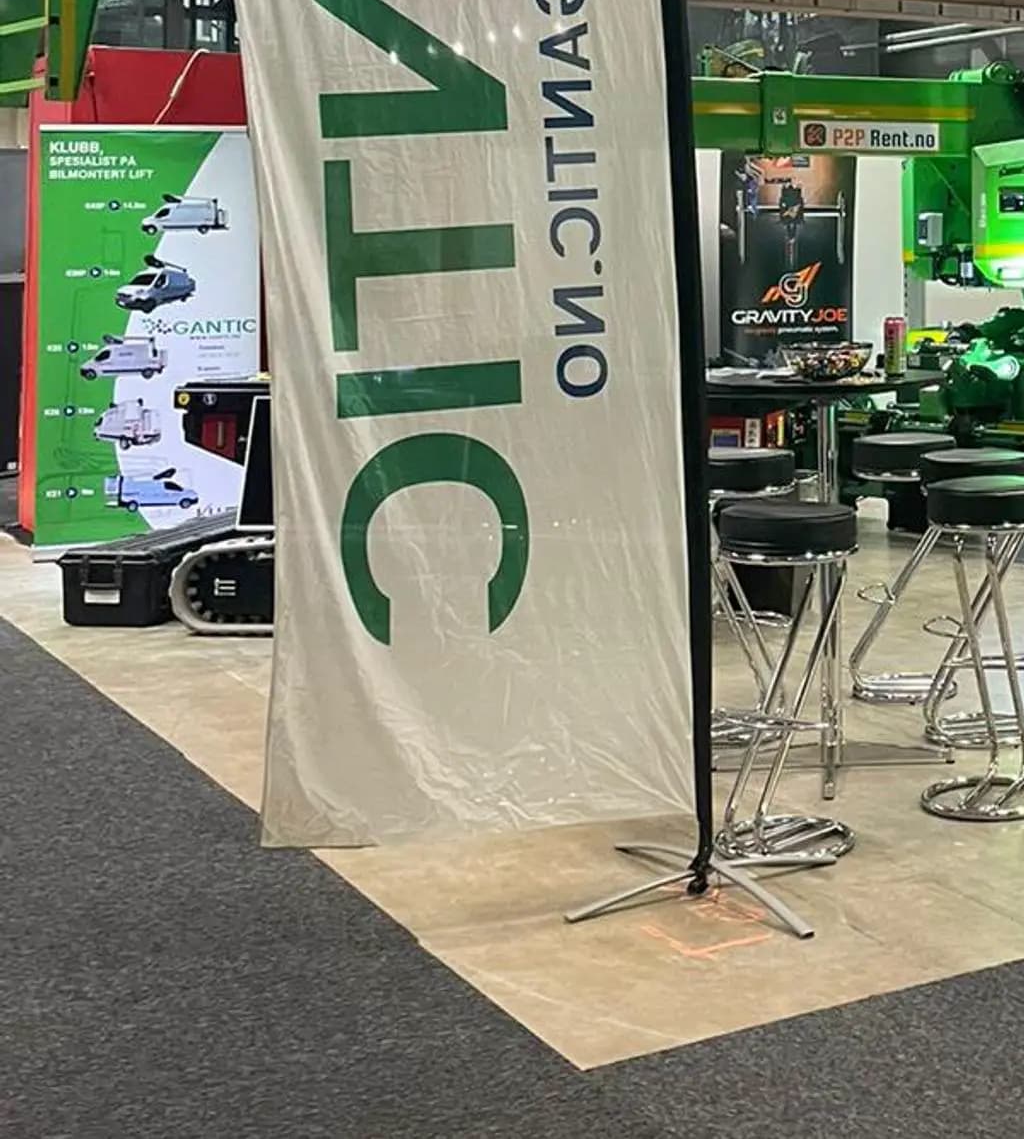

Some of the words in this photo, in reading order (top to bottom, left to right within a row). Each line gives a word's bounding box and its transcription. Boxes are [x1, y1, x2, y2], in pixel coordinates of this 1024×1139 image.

[832, 128, 866, 147] P2P
[870, 128, 936, 148] Rent.no
[49, 141, 104, 155] KLUBB,
[49, 156, 117, 167] SPESIALIST
[49, 169, 125, 180] BILMONTERT
[128, 169, 154, 179] LIFT
[173, 319, 257, 336] GANTIC
